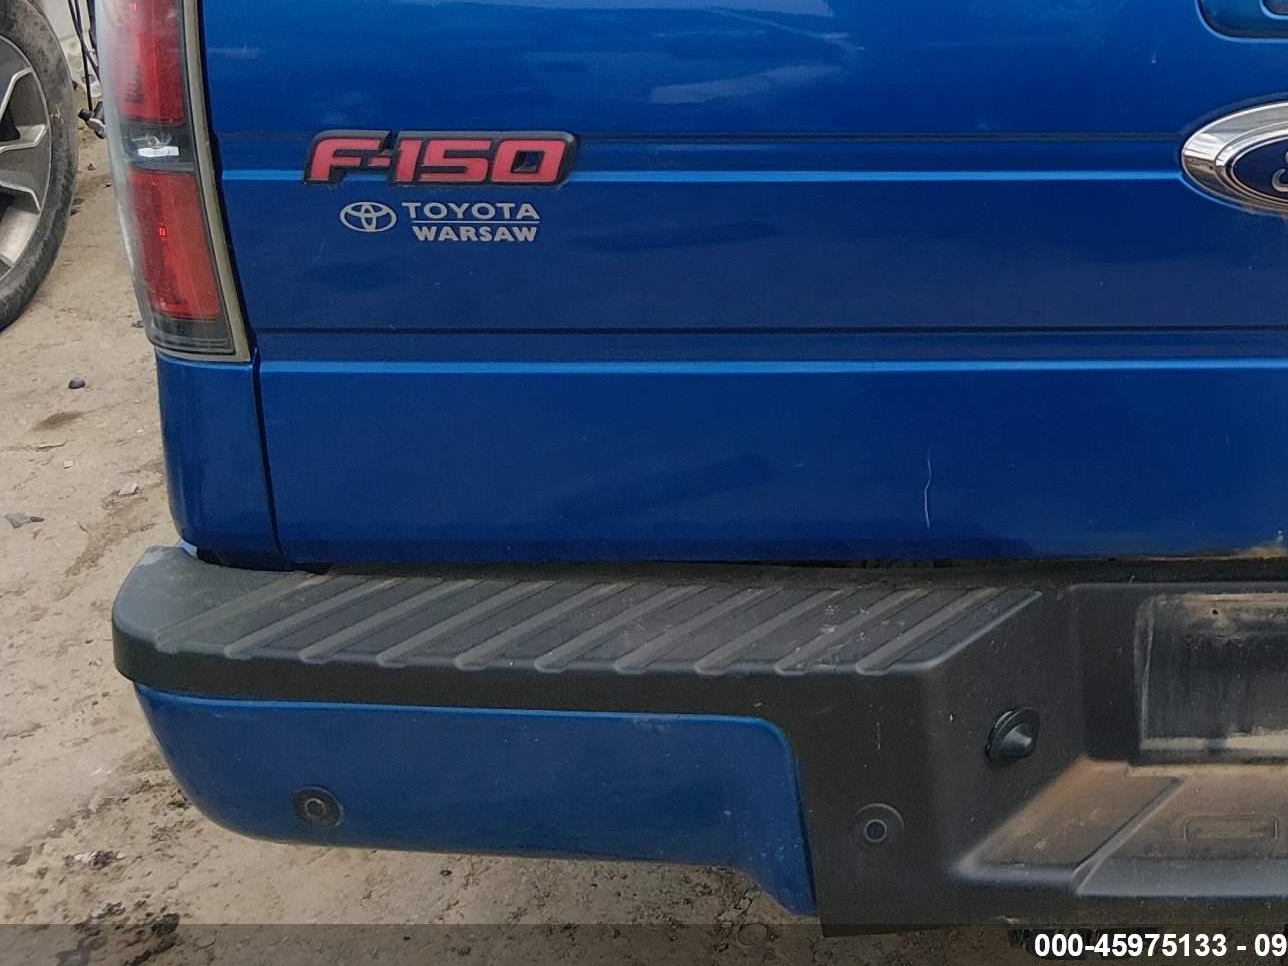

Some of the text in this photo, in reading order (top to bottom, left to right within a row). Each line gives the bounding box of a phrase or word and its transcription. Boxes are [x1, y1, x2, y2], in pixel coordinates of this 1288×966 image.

[306, 132, 573, 184] F-150
[401, 202, 541, 220] TOYOTA
[411, 226, 538, 243] WARSAW
